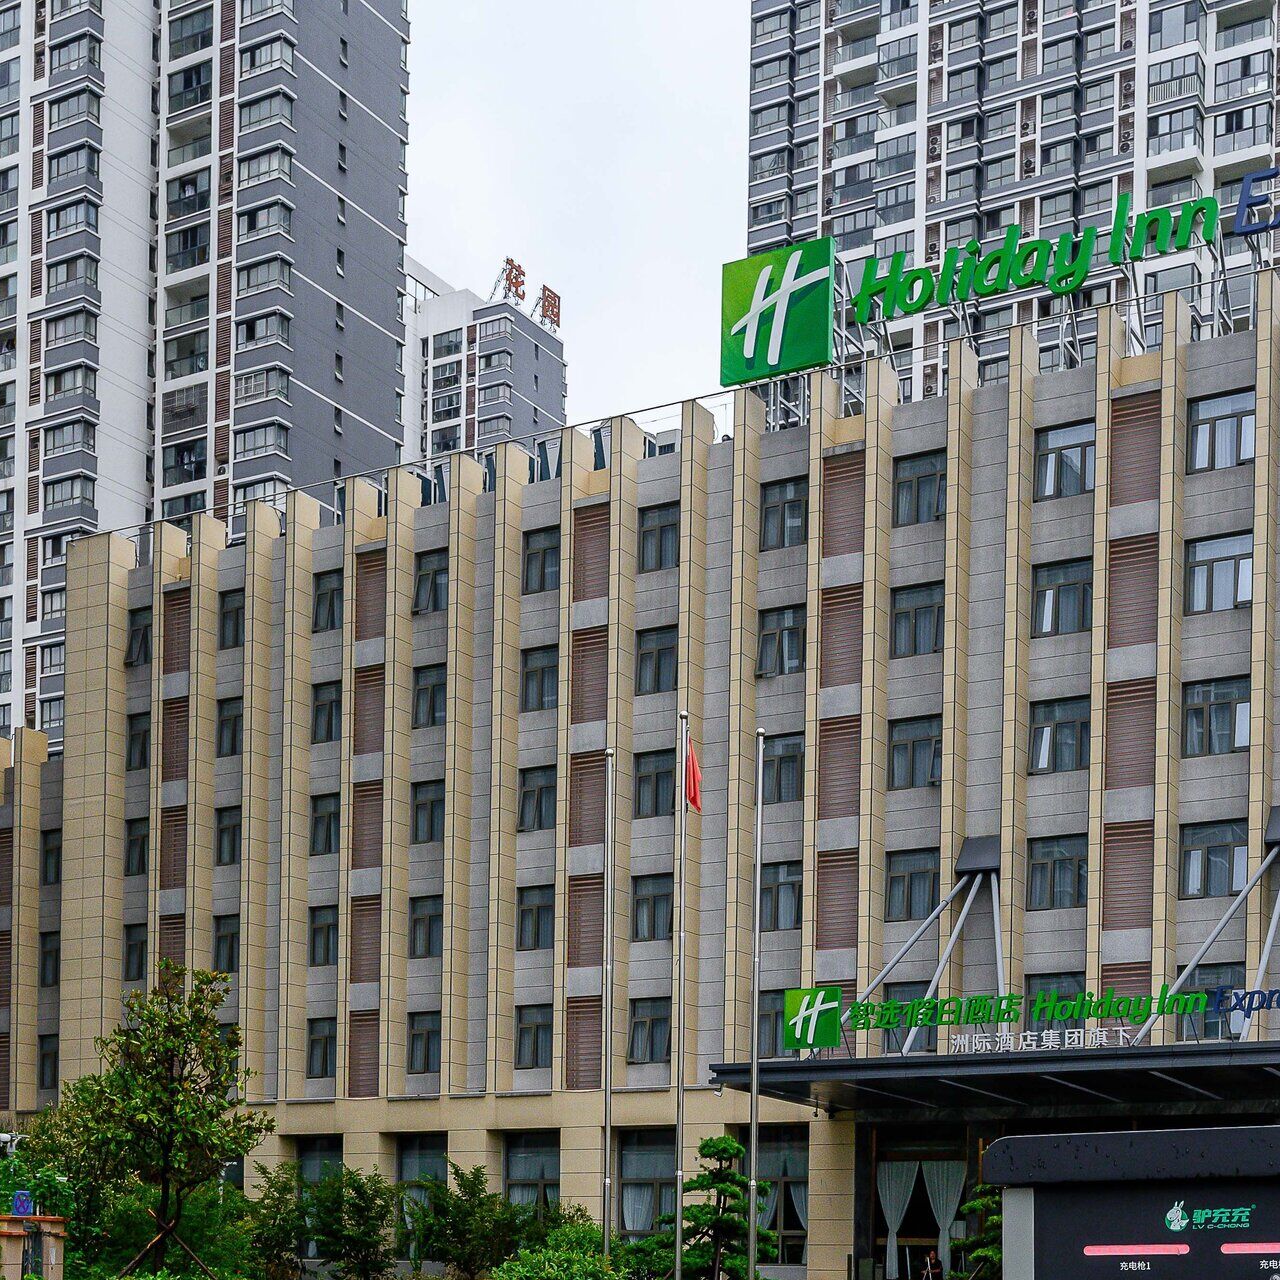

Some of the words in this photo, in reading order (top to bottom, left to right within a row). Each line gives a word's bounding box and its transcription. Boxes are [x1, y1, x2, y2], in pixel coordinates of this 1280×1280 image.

[852, 224, 1098, 325] Holiday
[1108, 193, 1219, 265] Inn
[849, 993, 1024, 1031] 智选假日酒店
[1032, 987, 1153, 1025] Holiday
[1157, 984, 1208, 1015] Inn
[950, 1026, 1132, 1053] 洲际酒店集团旗下
[1193, 1207, 1250, 1223] 驴充充
[1192, 1222, 1205, 1230] LV
[1119, 1261, 1151, 1271] 充电枪1
